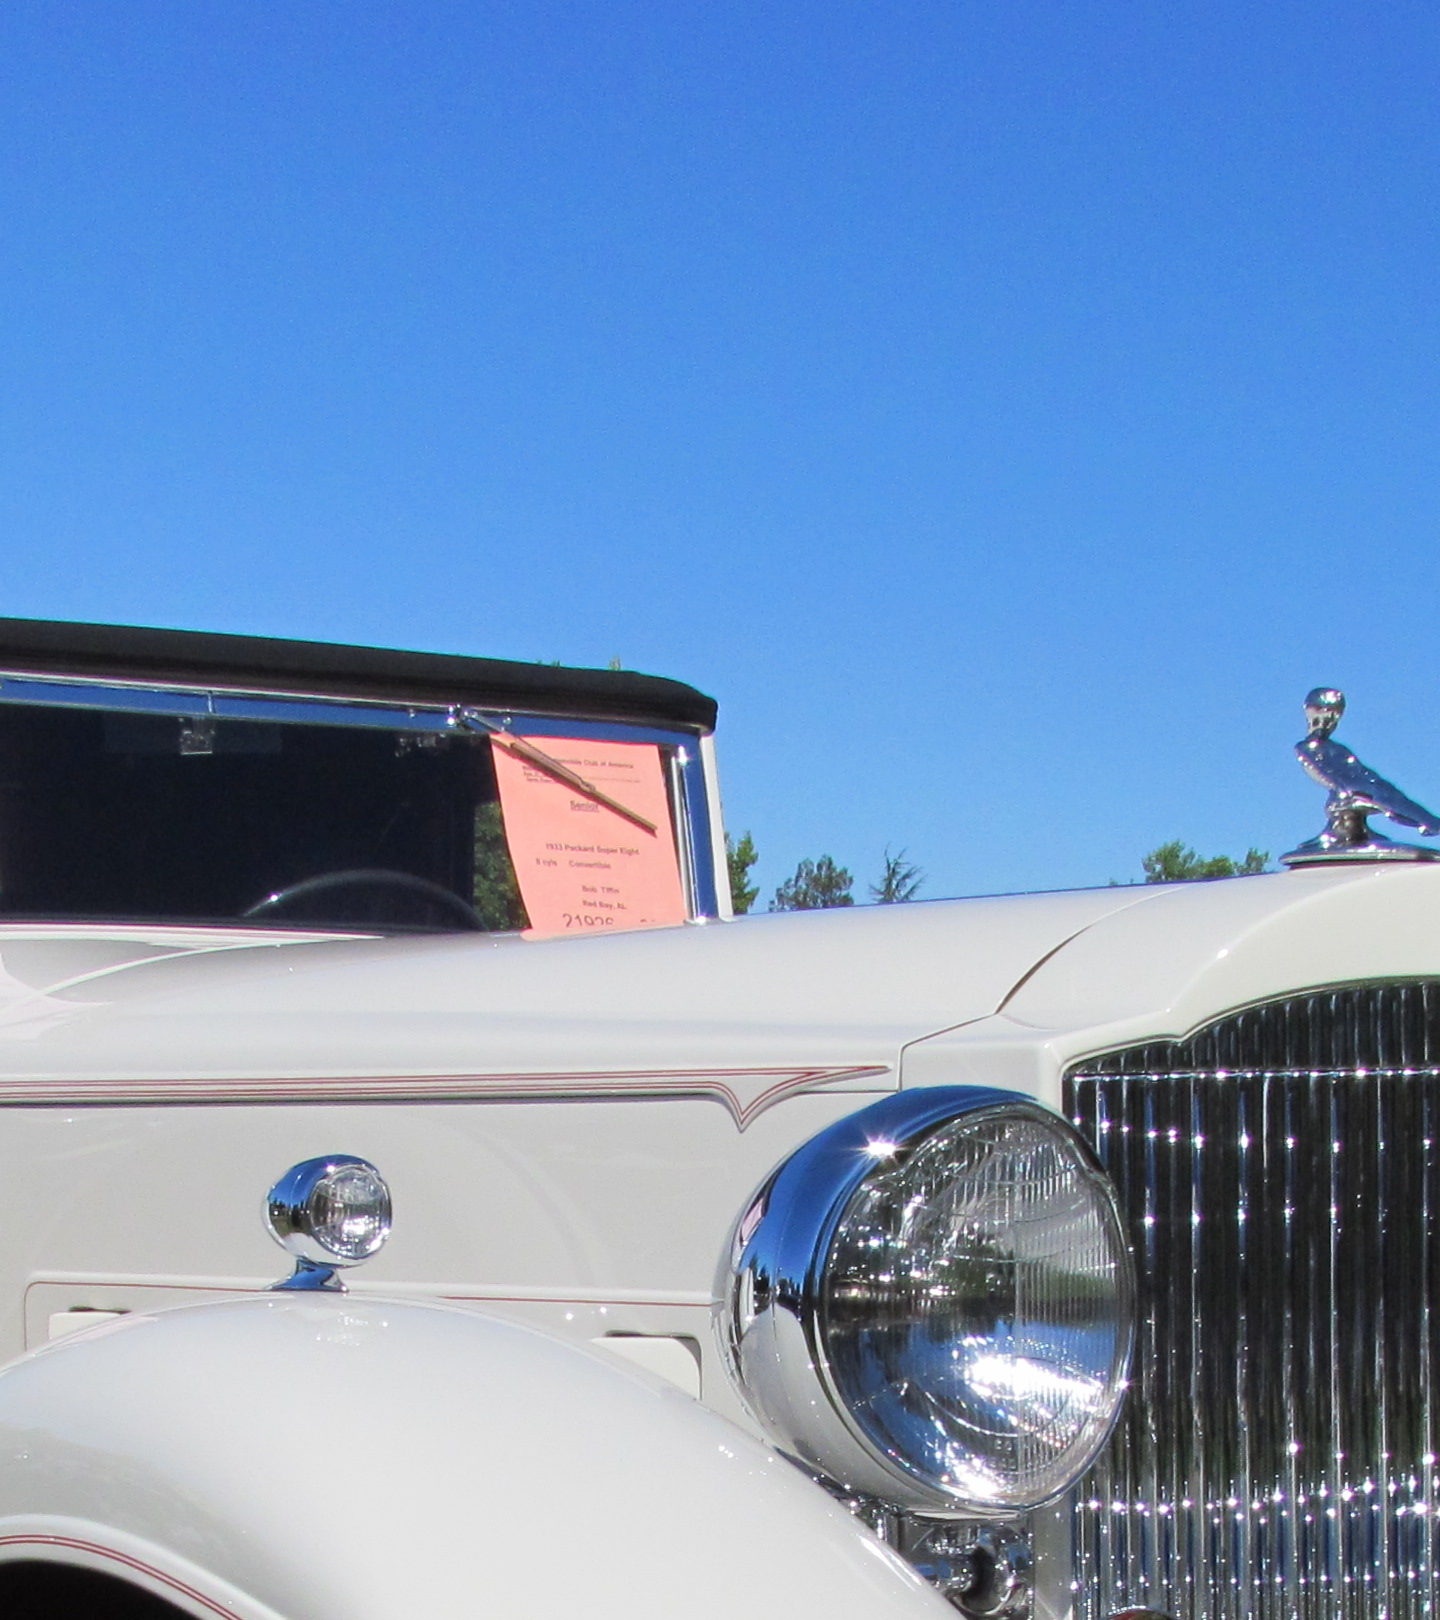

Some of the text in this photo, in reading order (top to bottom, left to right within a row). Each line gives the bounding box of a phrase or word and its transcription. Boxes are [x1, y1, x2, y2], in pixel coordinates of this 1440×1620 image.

[570, 800, 599, 812] Senior
[545, 842, 640, 857] 1933 Packard Super Eight
[568, 860, 611, 869] Convertible
